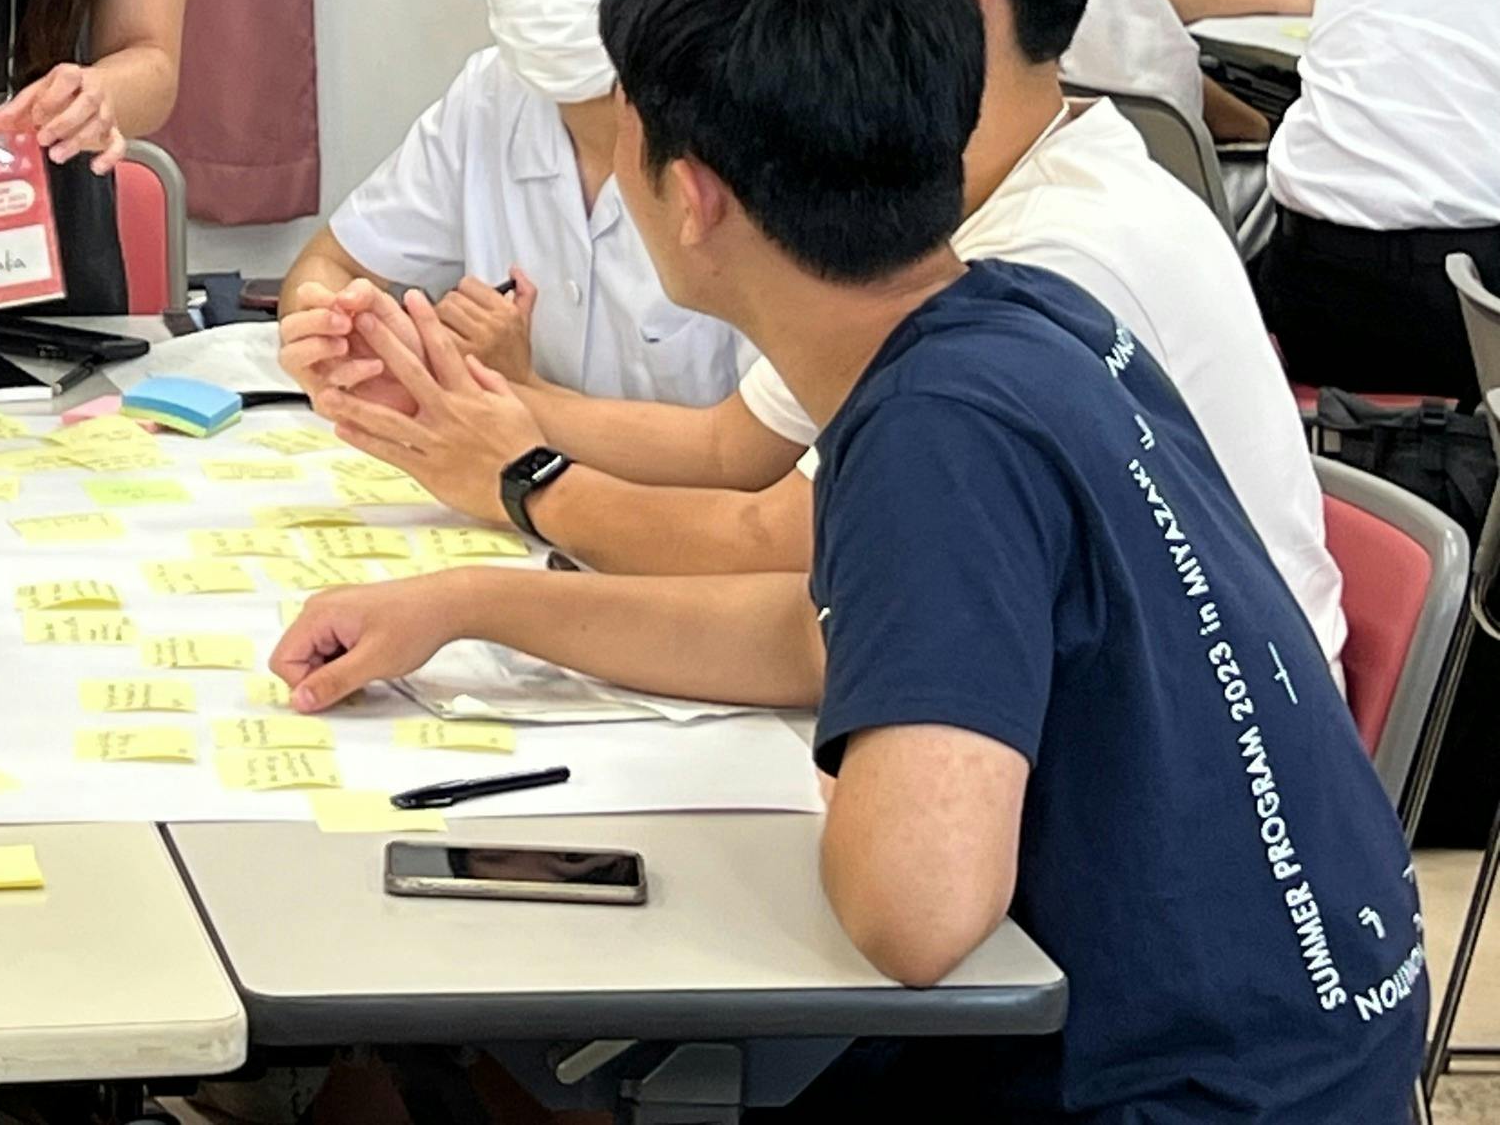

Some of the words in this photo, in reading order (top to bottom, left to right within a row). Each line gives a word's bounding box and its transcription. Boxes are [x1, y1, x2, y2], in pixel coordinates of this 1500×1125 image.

[1128, 459, 1210, 597] MIYAZAKI
[1199, 602, 1222, 636] in
[1207, 640, 1255, 722] 2023
[1237, 725, 1302, 881] PROGRAM
[1284, 879, 1348, 1011] SUMMER
